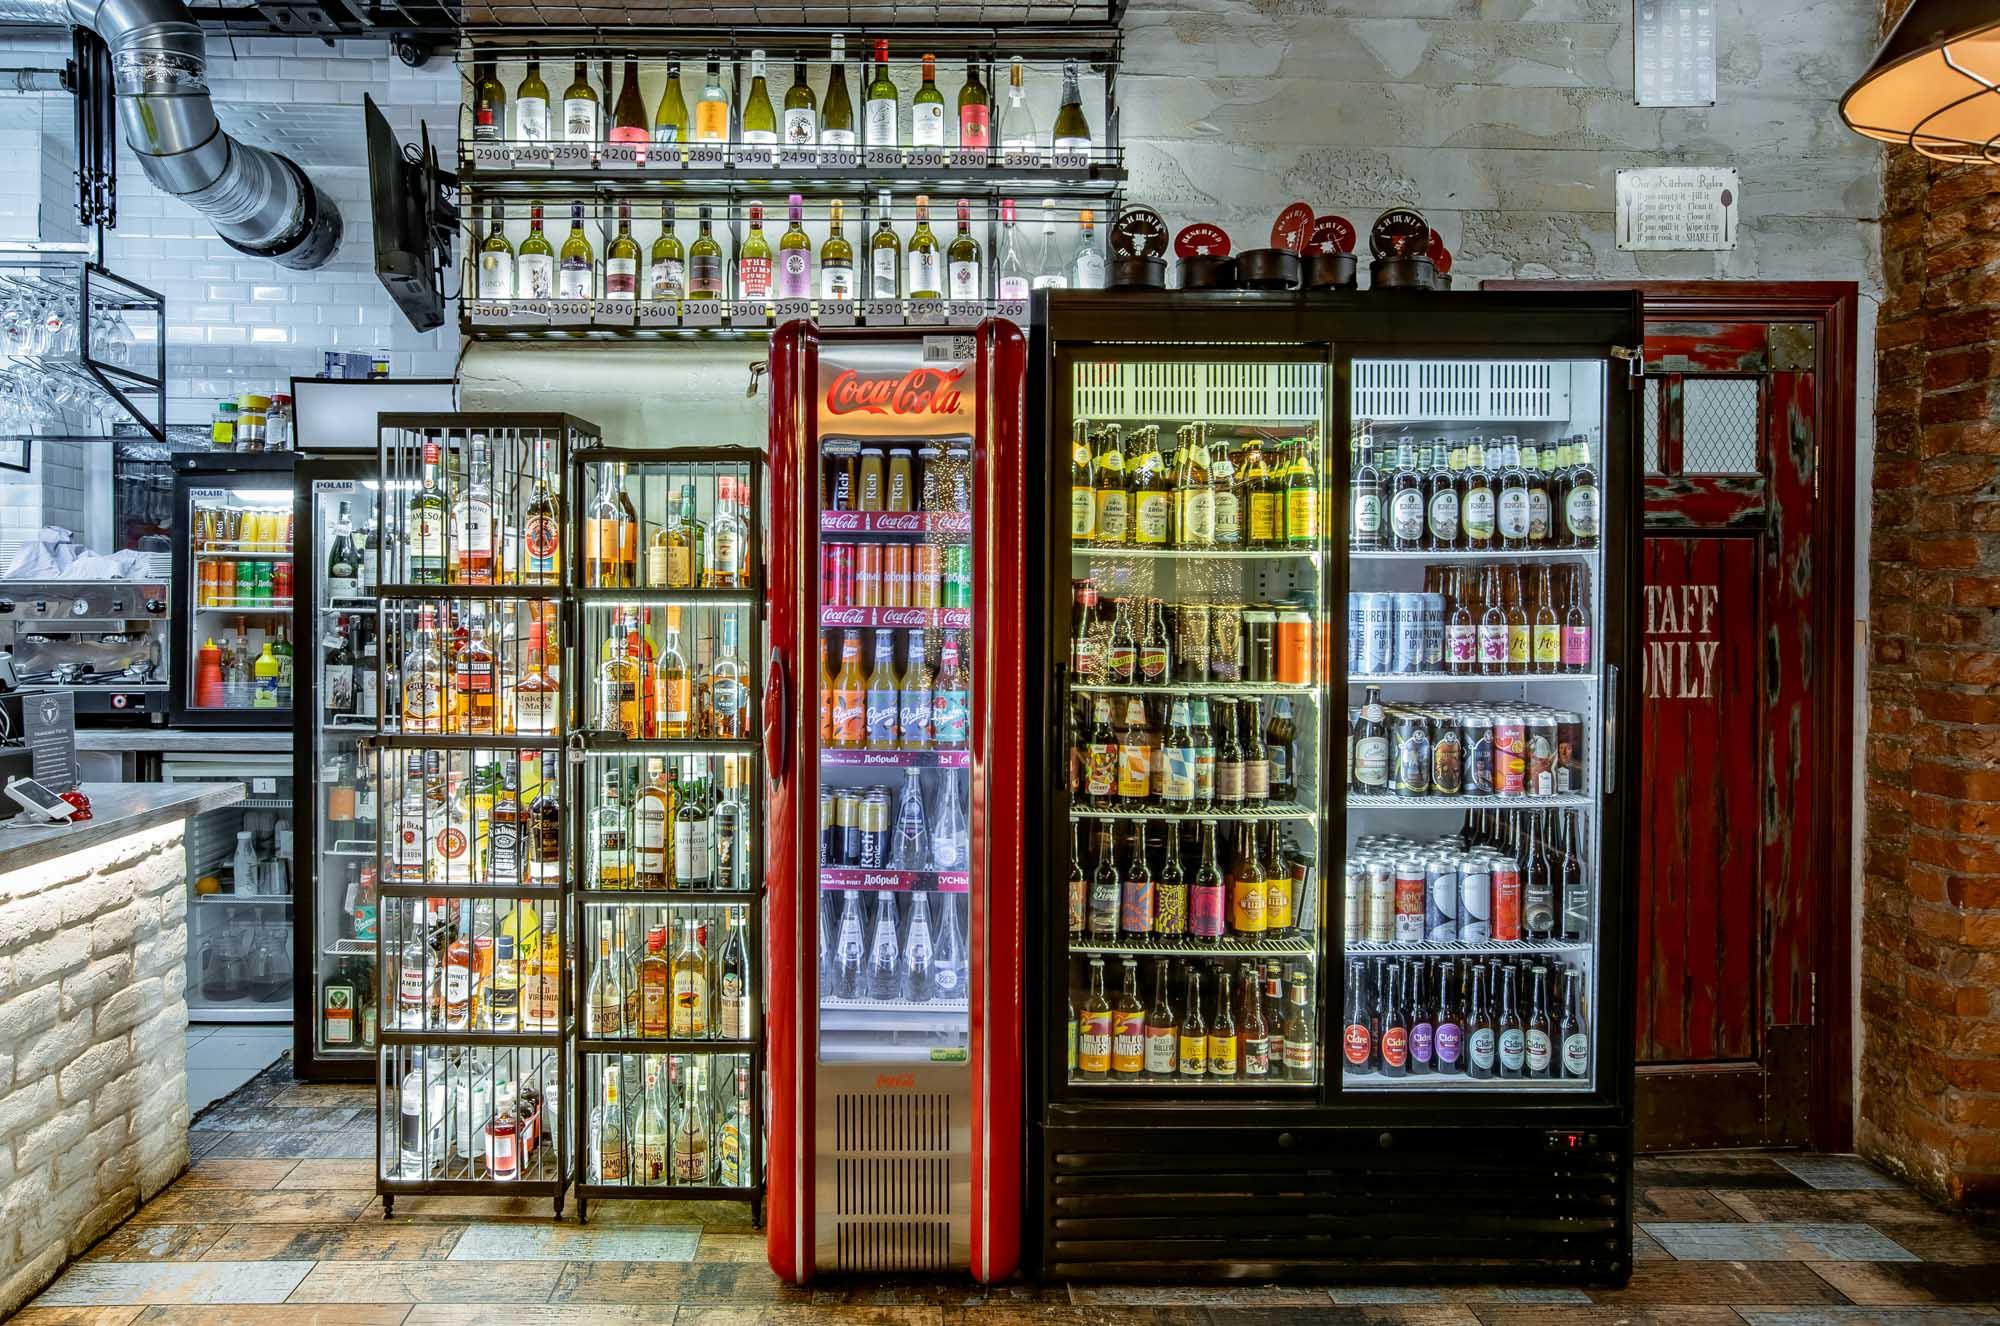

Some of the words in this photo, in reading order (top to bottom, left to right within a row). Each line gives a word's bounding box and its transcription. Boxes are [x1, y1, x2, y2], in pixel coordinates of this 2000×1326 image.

[477, 148, 510, 162] 2900
[515, 149, 549, 161] 2490
[556, 147, 588, 160] 2590
[602, 148, 637, 161] 4200
[647, 149, 680, 162] 4500
[689, 150, 722, 162] 2890
[736, 152, 771, 163] 3490
[781, 151, 816, 163] 2490
[822, 152, 856, 165] 3300
[868, 151, 902, 164] 2860
[908, 153, 942, 166] 2590
[951, 154, 984, 166] 2890
[1006, 154, 1040, 167] 3390
[1054, 155, 1087, 167] 1990
[1656, 175, 1693, 188] Kitchen
[1686, 232, 1712, 242] SHARE
[553, 302, 588, 315] 3900
[596, 302, 633, 315] 2890
[642, 304, 676, 317] 3600
[684, 303, 719, 315] 3200
[731, 305, 766, 316] 3900
[775, 302, 809, 315] 2590
[820, 303, 854, 315] 2590
[868, 303, 902, 315] 2590
[951, 304, 983, 317] 3900
[827, 367, 967, 416] Coca-Cola
[316, 481, 353, 489] POLAIR
[838, 472, 849, 499] Rich
[866, 473, 877, 500] Rich
[893, 473, 904, 500] Rich
[191, 489, 223, 497] POLAIR
[1529, 503, 1546, 511] NGEL
[1643, 585, 1719, 633] TAFF
[1642, 641, 1720, 698] NLY
[863, 754, 899, 765] Добрый
[861, 831, 874, 869] Rich
[863, 873, 899, 886] Добрый
[1346, 1034, 1368, 1044] Cidre
[1386, 1037, 1407, 1047] Cidre
[1413, 1033, 1432, 1042] Cidre
[1438, 1033, 1459, 1043] Cidre
